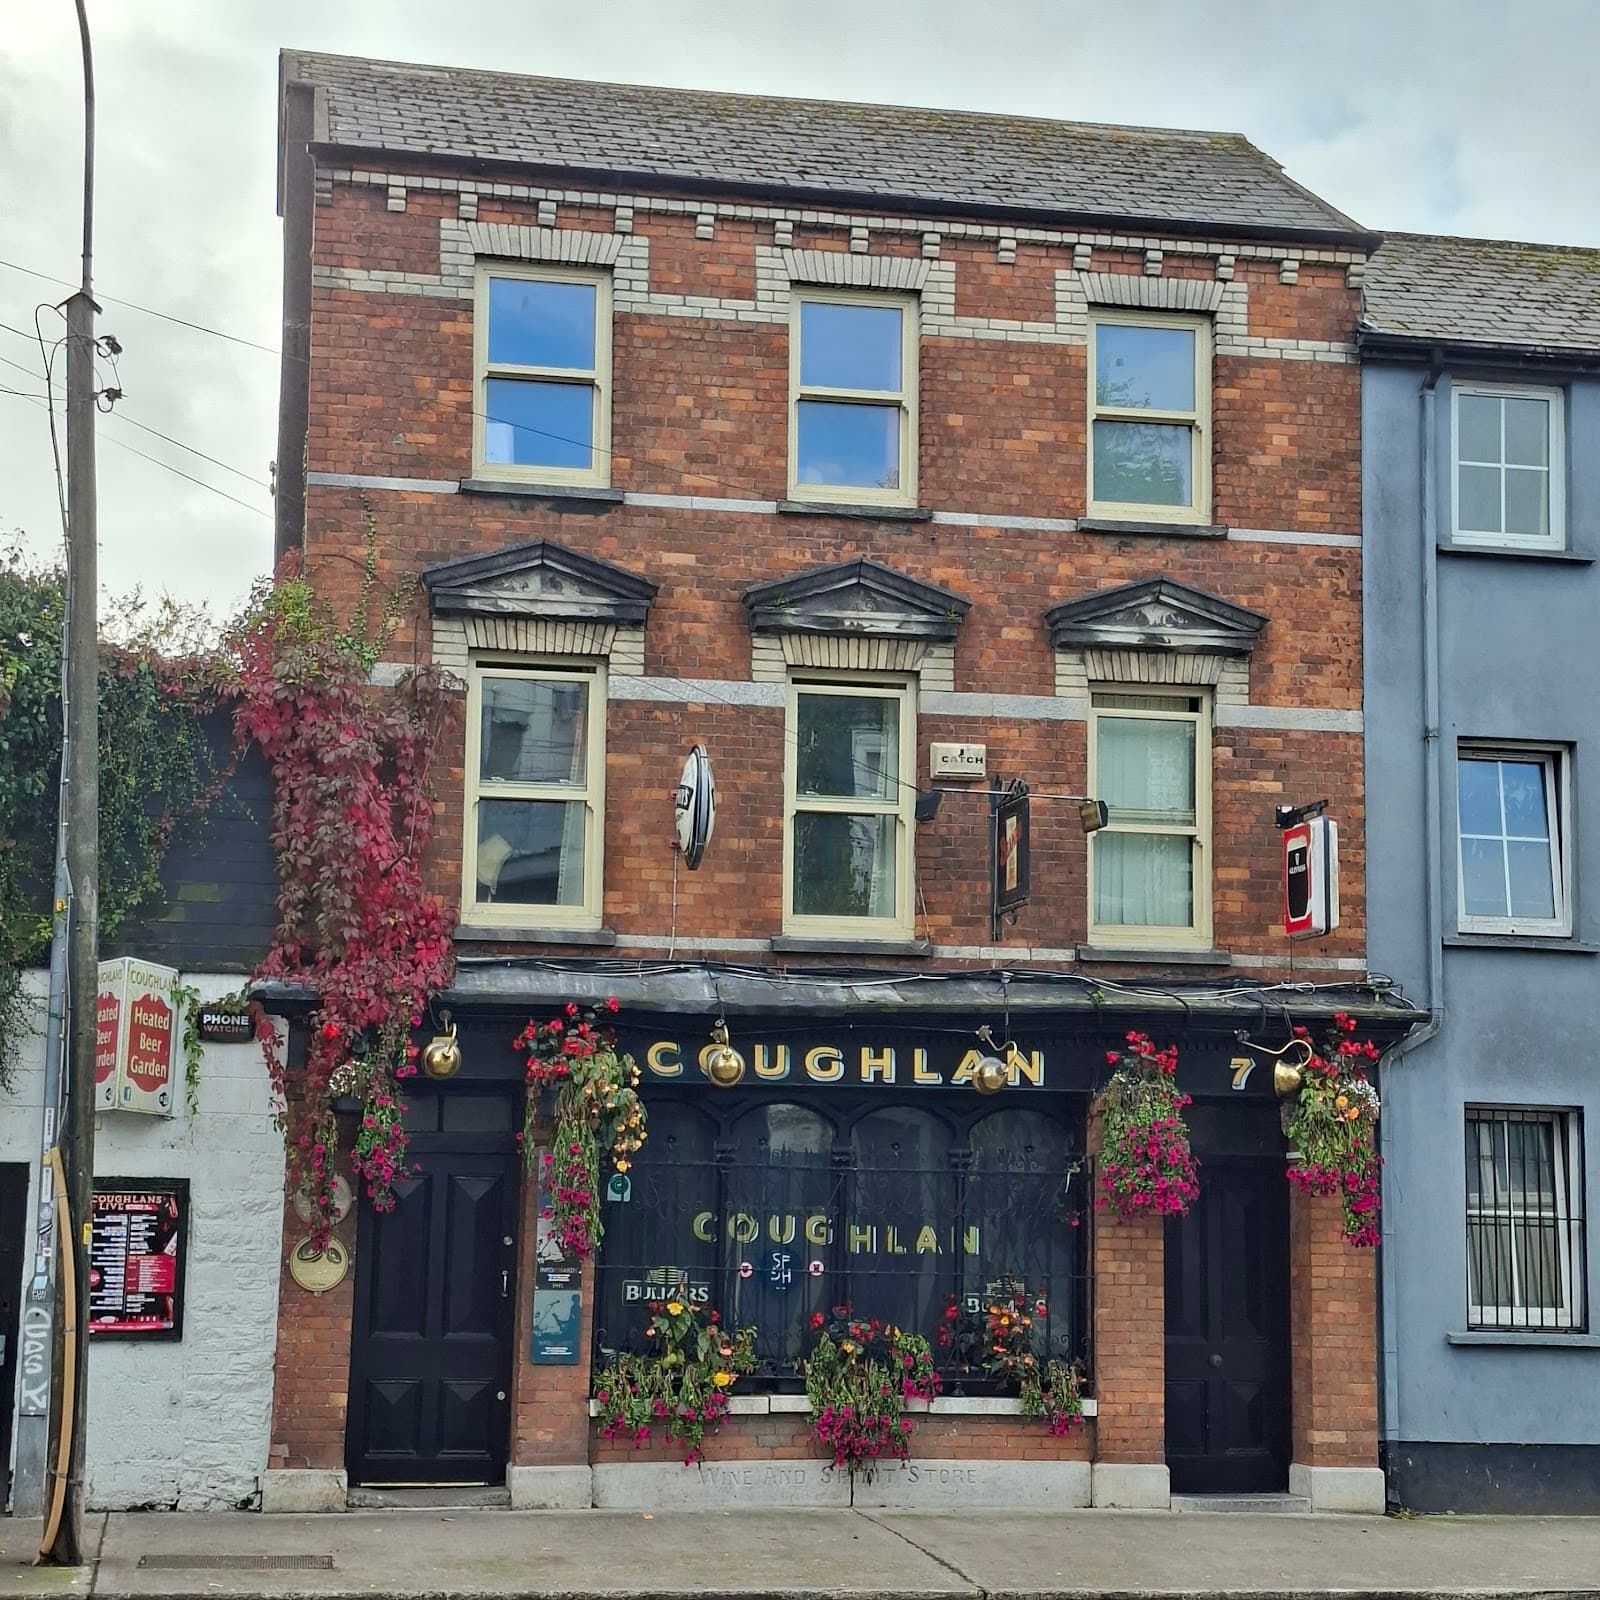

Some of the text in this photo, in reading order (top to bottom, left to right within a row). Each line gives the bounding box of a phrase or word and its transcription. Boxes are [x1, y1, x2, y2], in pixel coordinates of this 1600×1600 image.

[97, 1003, 118, 1023] eated
[134, 1006, 170, 1031] Heated
[203, 1013, 249, 1026] PHONE
[203, 1025, 239, 1033] WATCH
[139, 1032, 163, 1053] Beer
[130, 1056, 168, 1079] Garden
[1230, 1058, 1256, 1090] 7
[100, 1202, 125, 1211] LIVE
[693, 1211, 980, 1255] COUGHLAN
[626, 1285, 709, 1302] BULMRS
[697, 1466, 753, 1486] WINE
[763, 1466, 806, 1486] AND
[820, 1465, 897, 1486] SPIT
